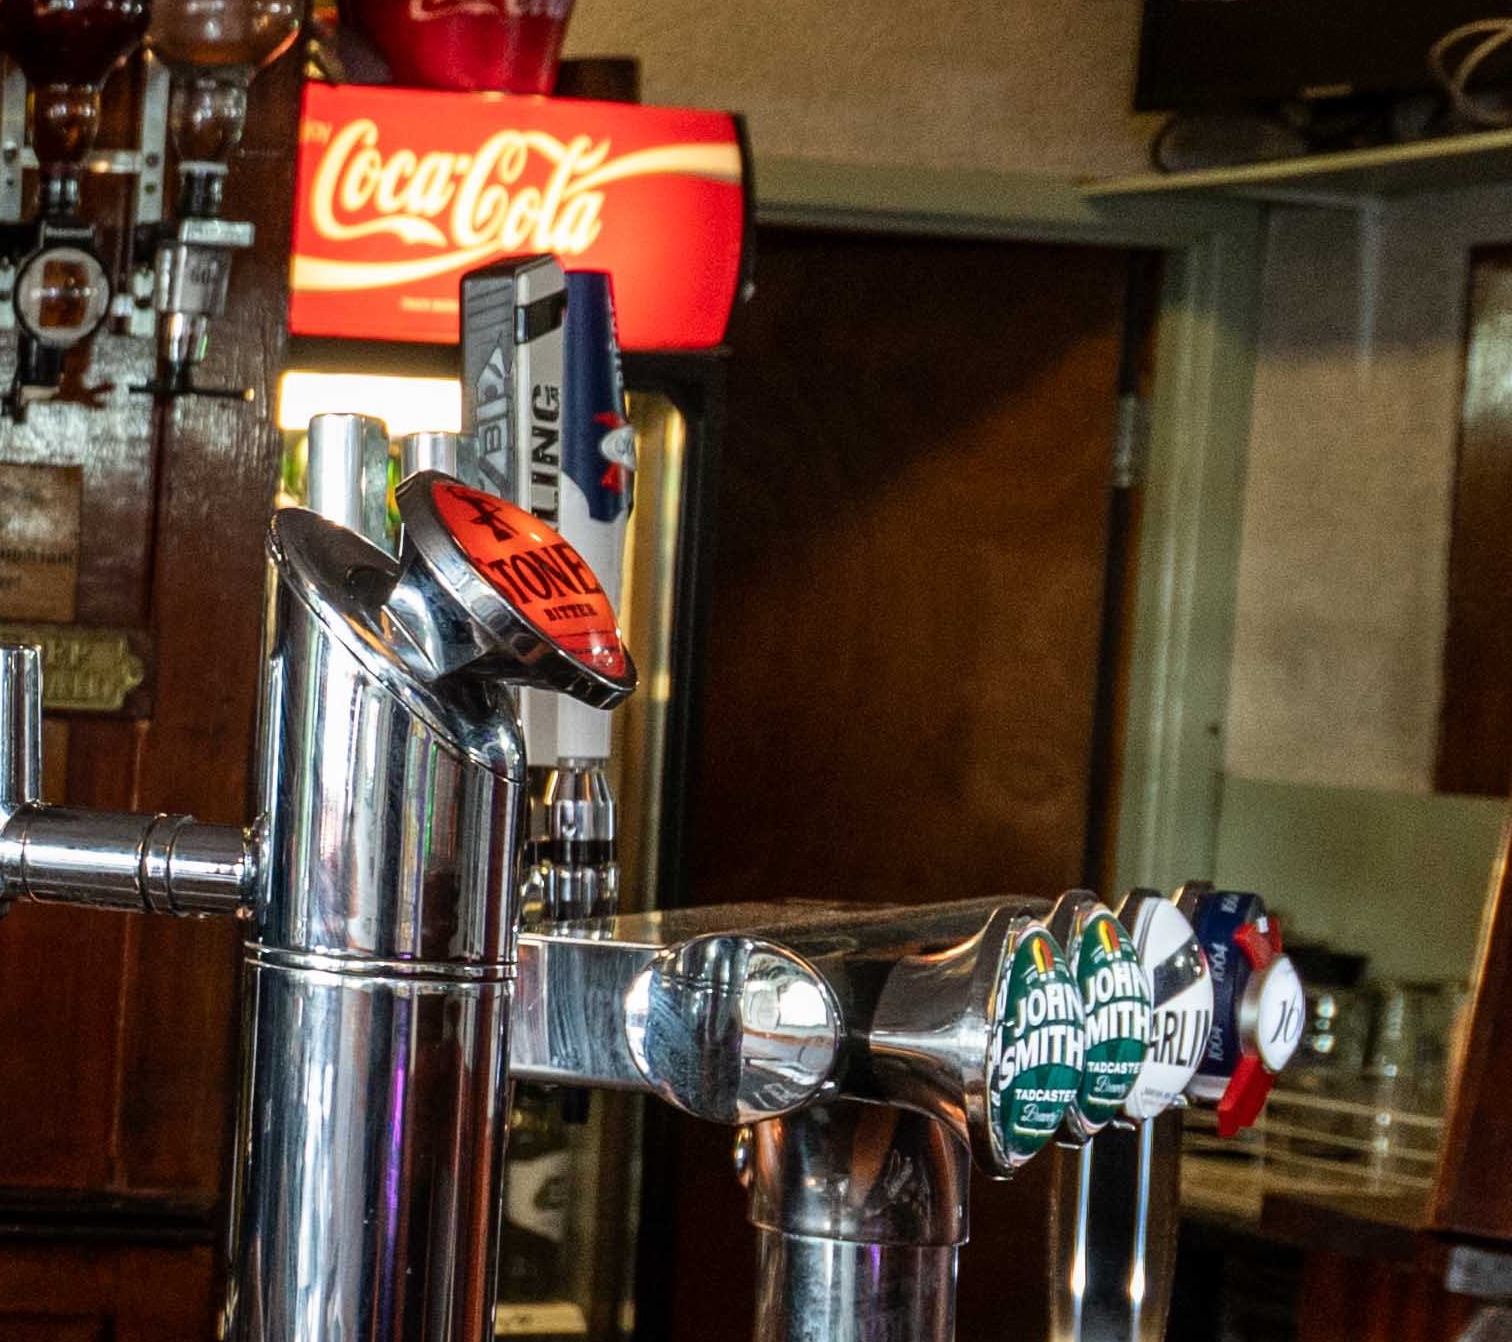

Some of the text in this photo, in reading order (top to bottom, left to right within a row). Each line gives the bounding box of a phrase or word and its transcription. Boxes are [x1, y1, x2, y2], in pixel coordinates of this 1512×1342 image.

[310, 119, 610, 255] Coca-Cola
[484, 545, 602, 604] TONE
[545, 601, 597, 622] BITTER
[1016, 983, 1081, 1037] JOHN
[999, 1025, 1085, 1089] SMITH
